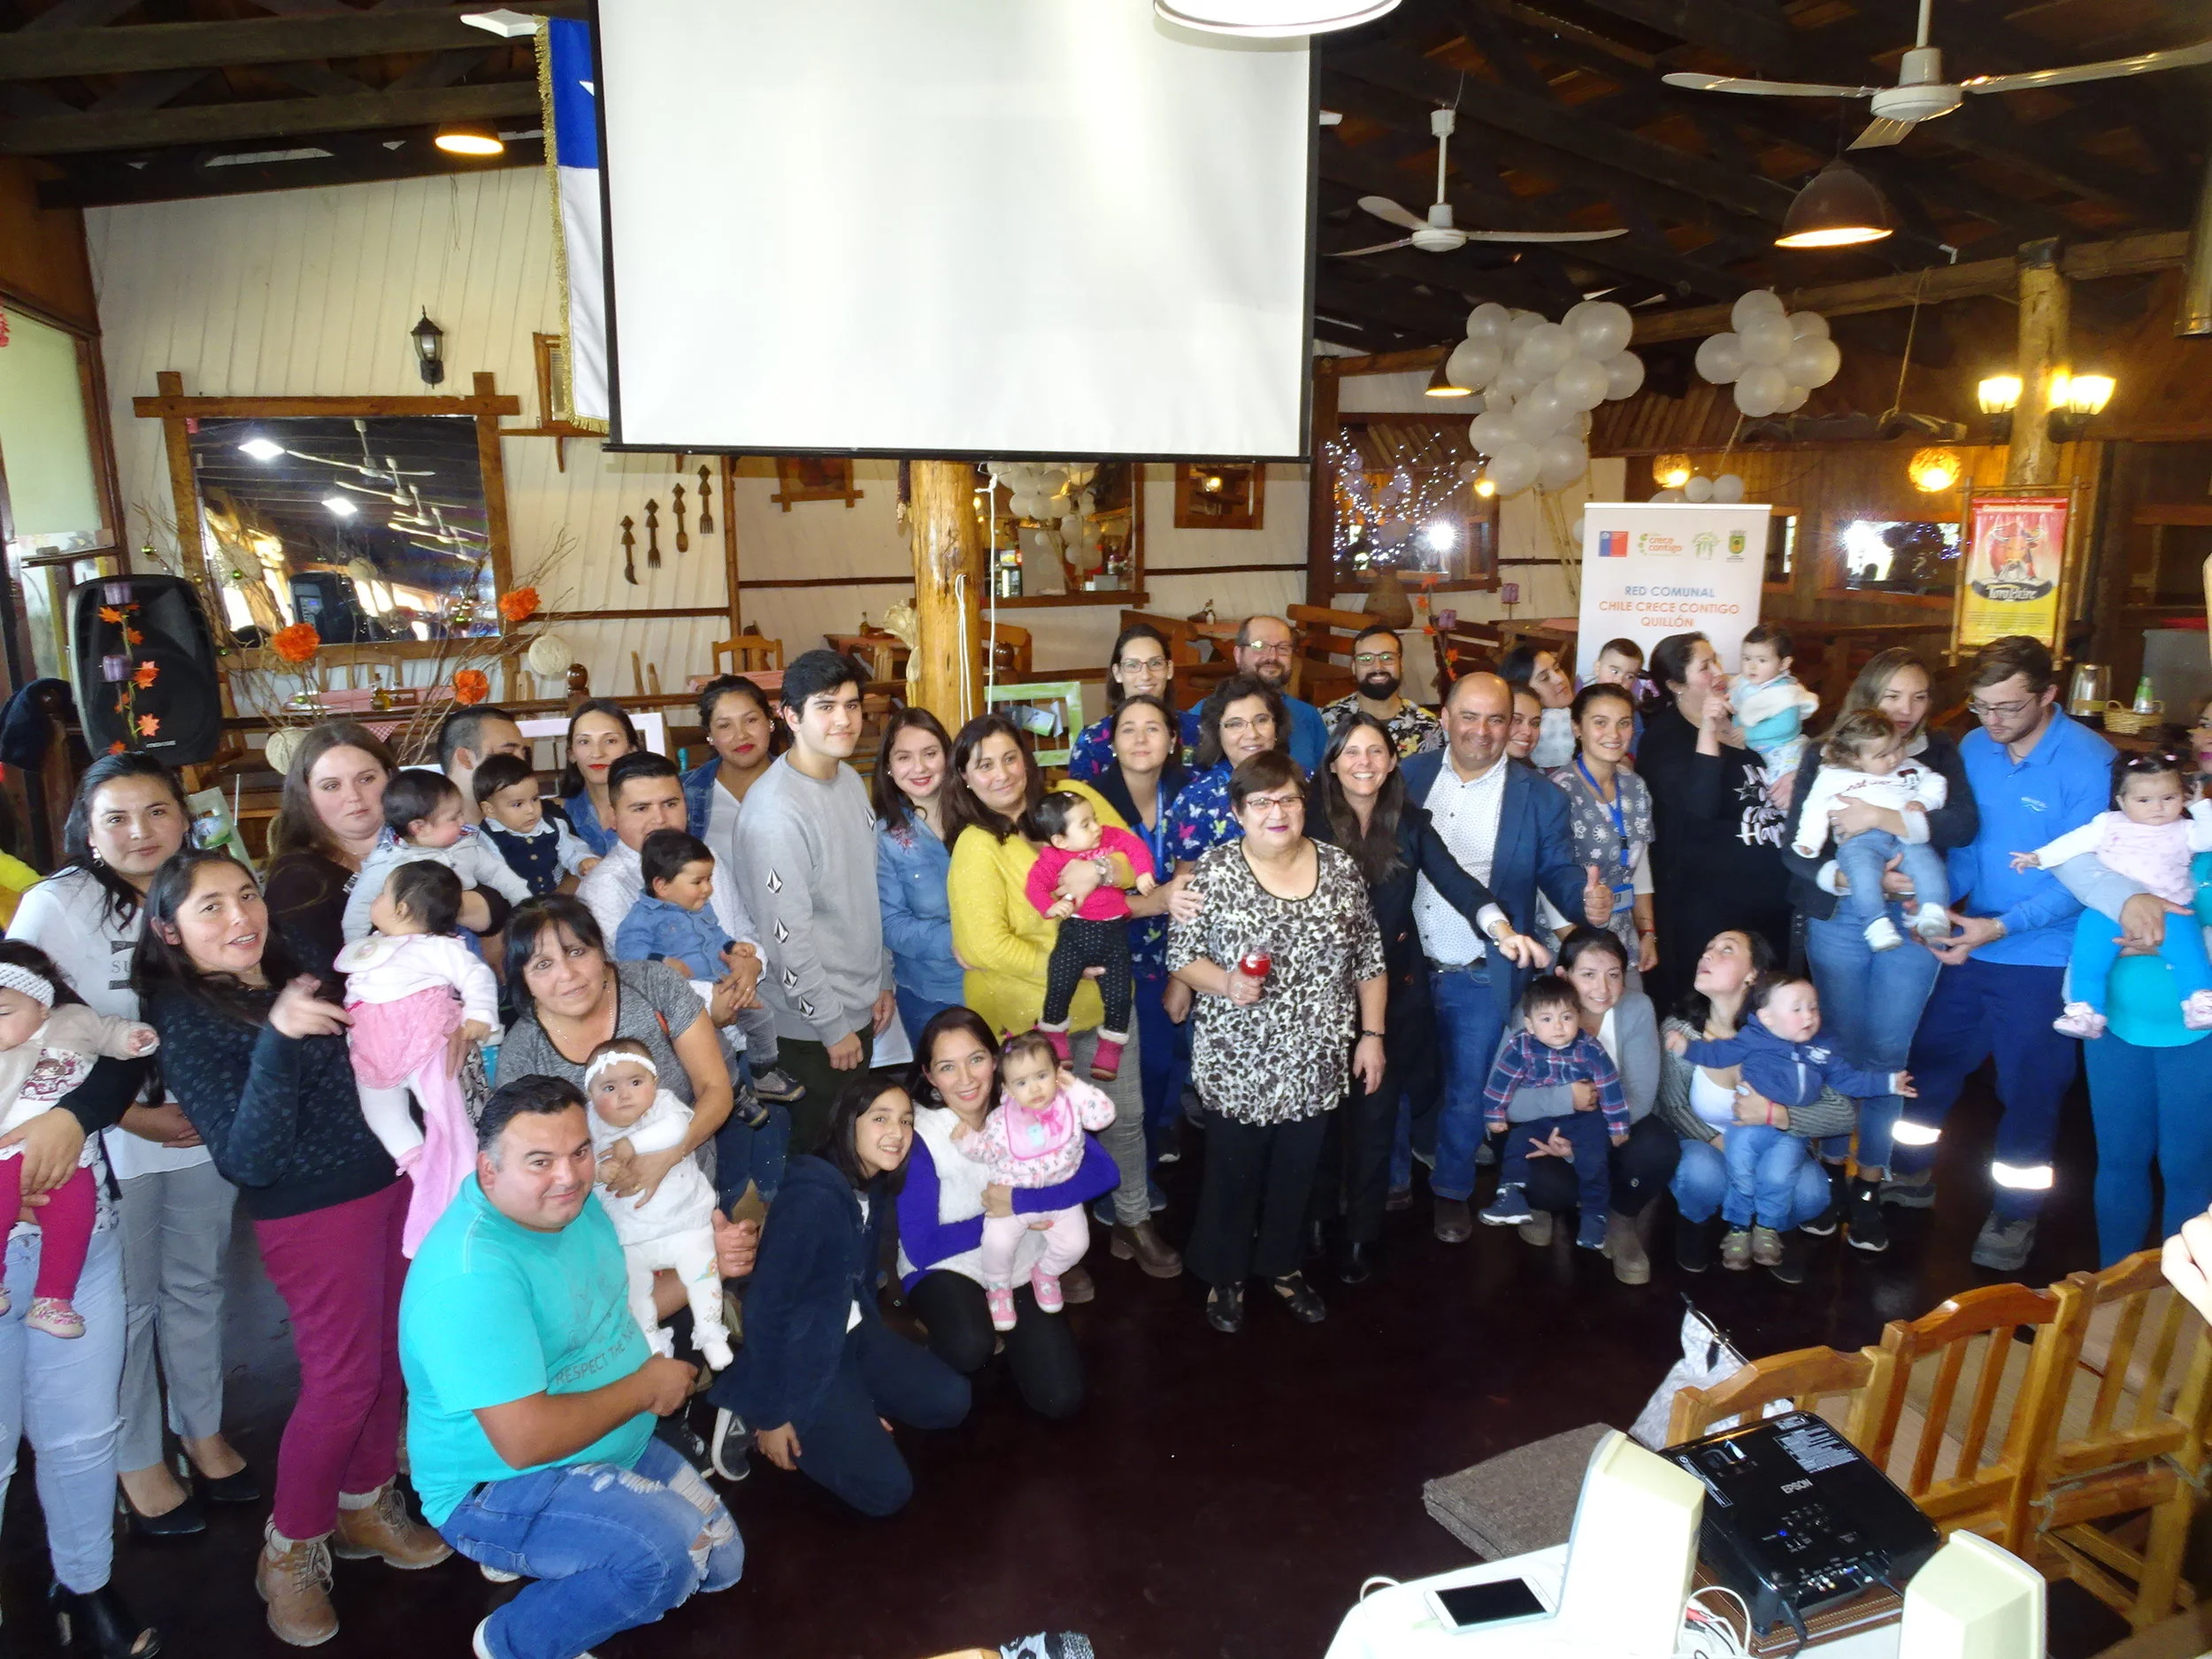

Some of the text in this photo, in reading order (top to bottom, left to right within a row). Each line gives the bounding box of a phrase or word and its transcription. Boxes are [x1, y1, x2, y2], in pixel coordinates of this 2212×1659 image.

[1648, 544, 1682, 553] contigo
[1624, 586, 1716, 598] RED COMUNAL
[1599, 601, 1740, 614] CHILE CRECE CONTIGO
[1640, 615, 1694, 627] QUILLÓN
[555, 1353, 609, 1386] RESPECT
[1780, 1478, 1814, 1494] EPSON
